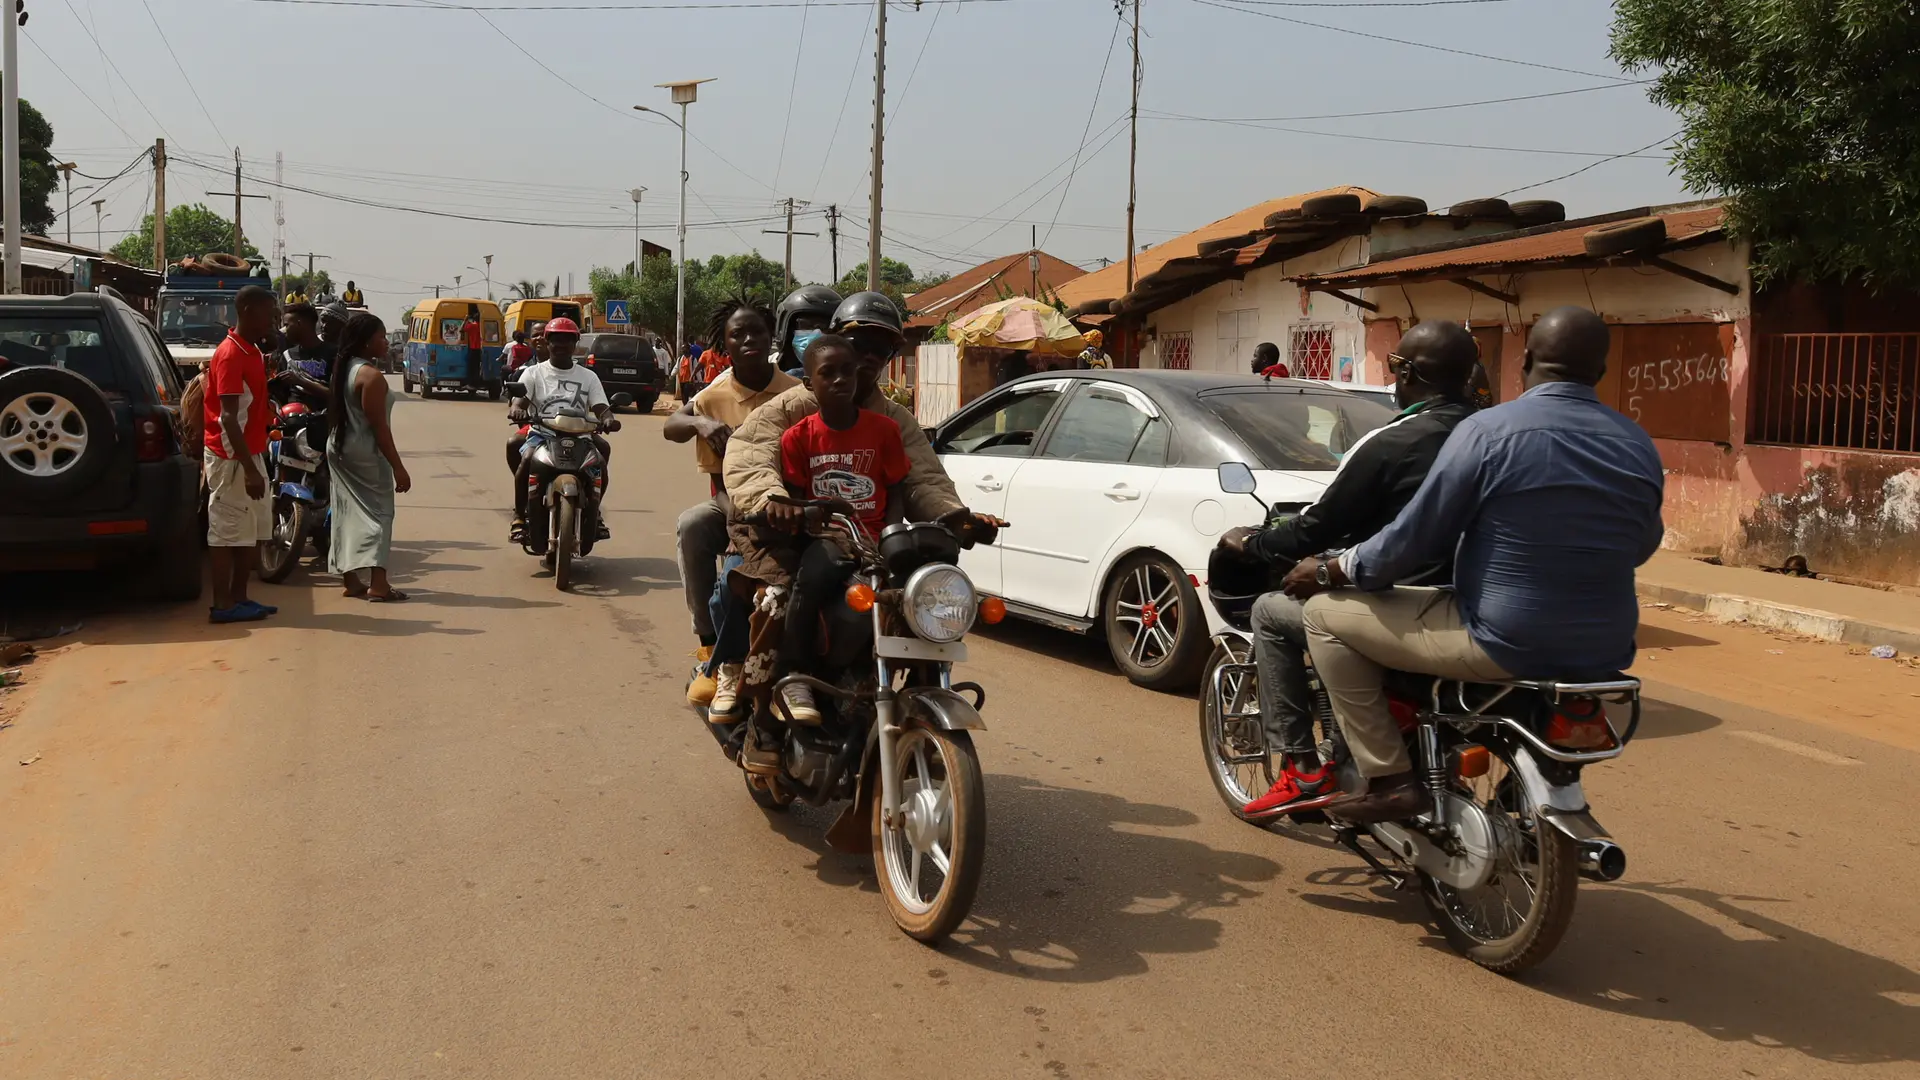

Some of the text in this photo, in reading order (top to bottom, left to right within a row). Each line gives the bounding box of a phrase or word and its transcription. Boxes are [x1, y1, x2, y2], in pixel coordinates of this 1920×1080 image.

[1627, 353, 1729, 393] 95535648
[1629, 396, 1643, 423] 5
[853, 449, 875, 473] 77
